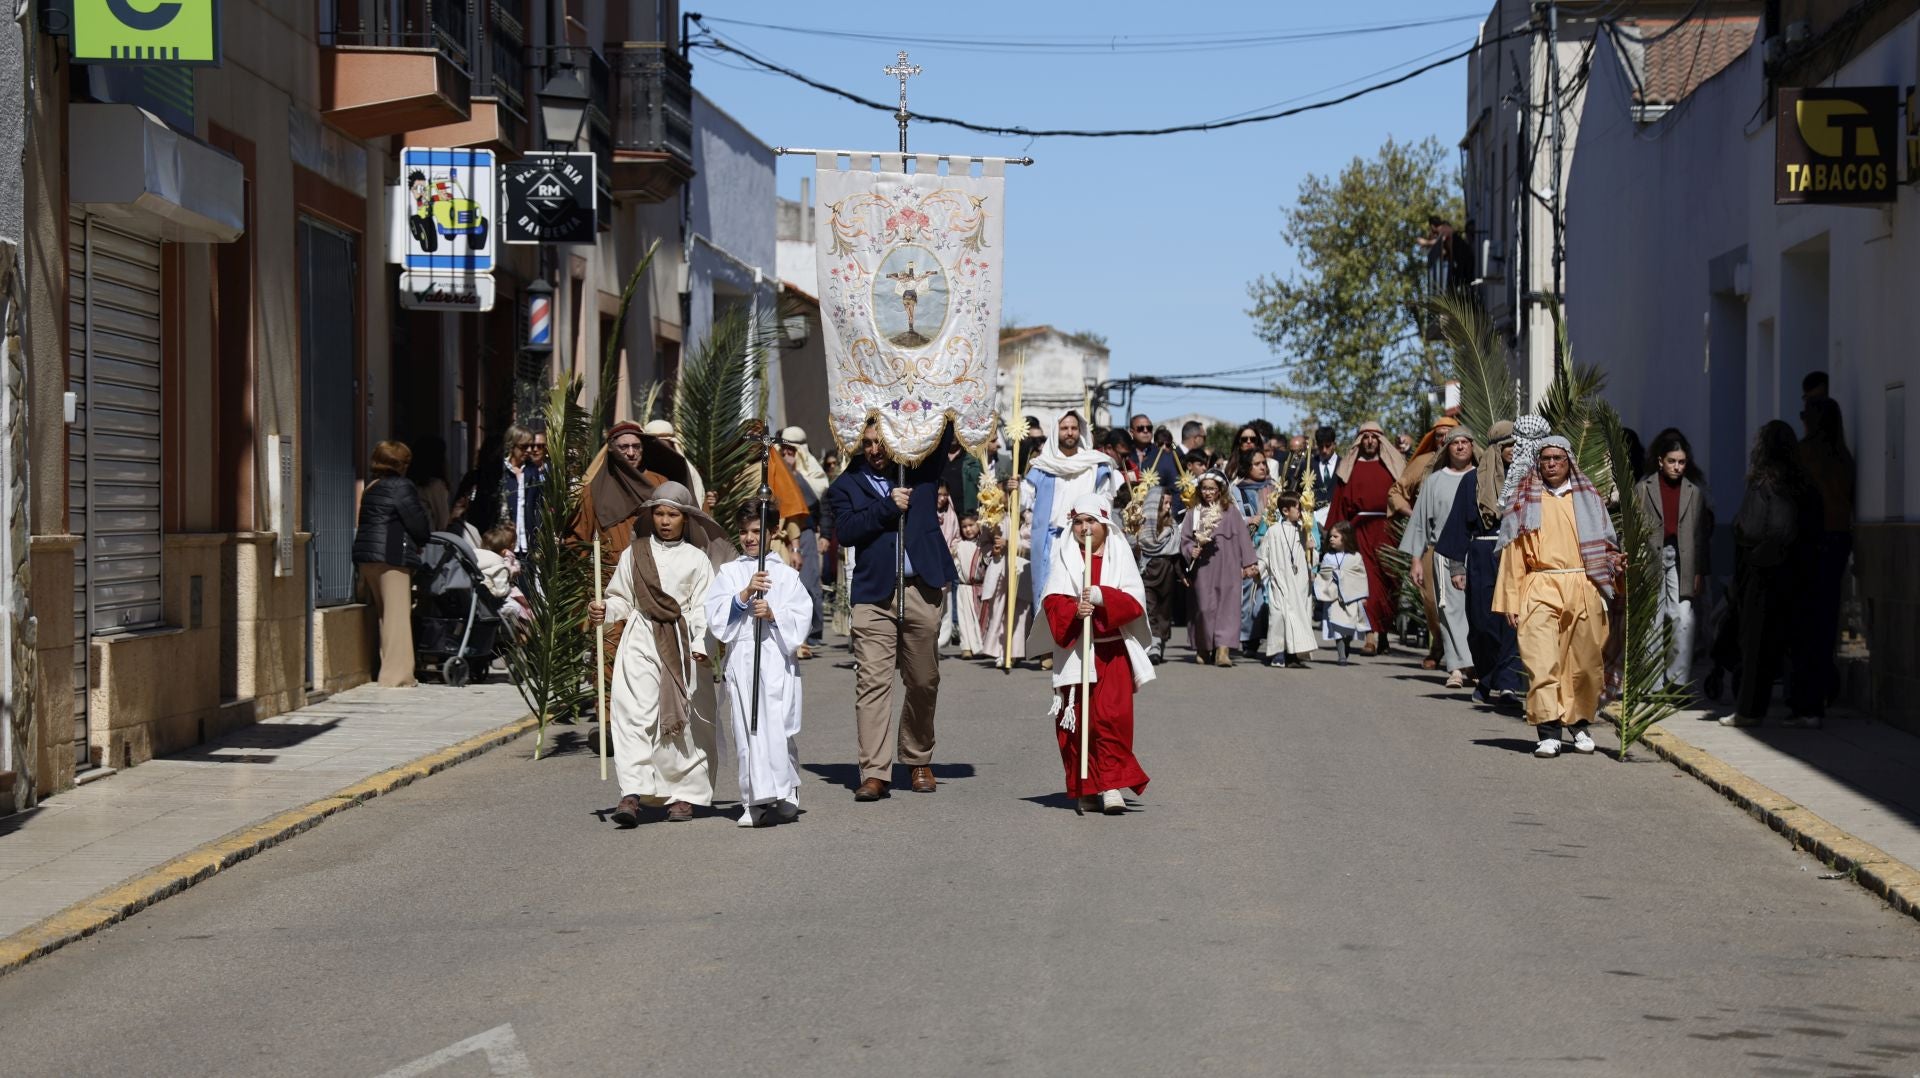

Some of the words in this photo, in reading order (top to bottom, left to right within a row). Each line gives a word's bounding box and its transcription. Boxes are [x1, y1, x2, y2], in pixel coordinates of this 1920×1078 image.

[1787, 162, 1887, 191] TABACOS
[539, 185, 561, 196] RM
[414, 282, 476, 304] Valverde
